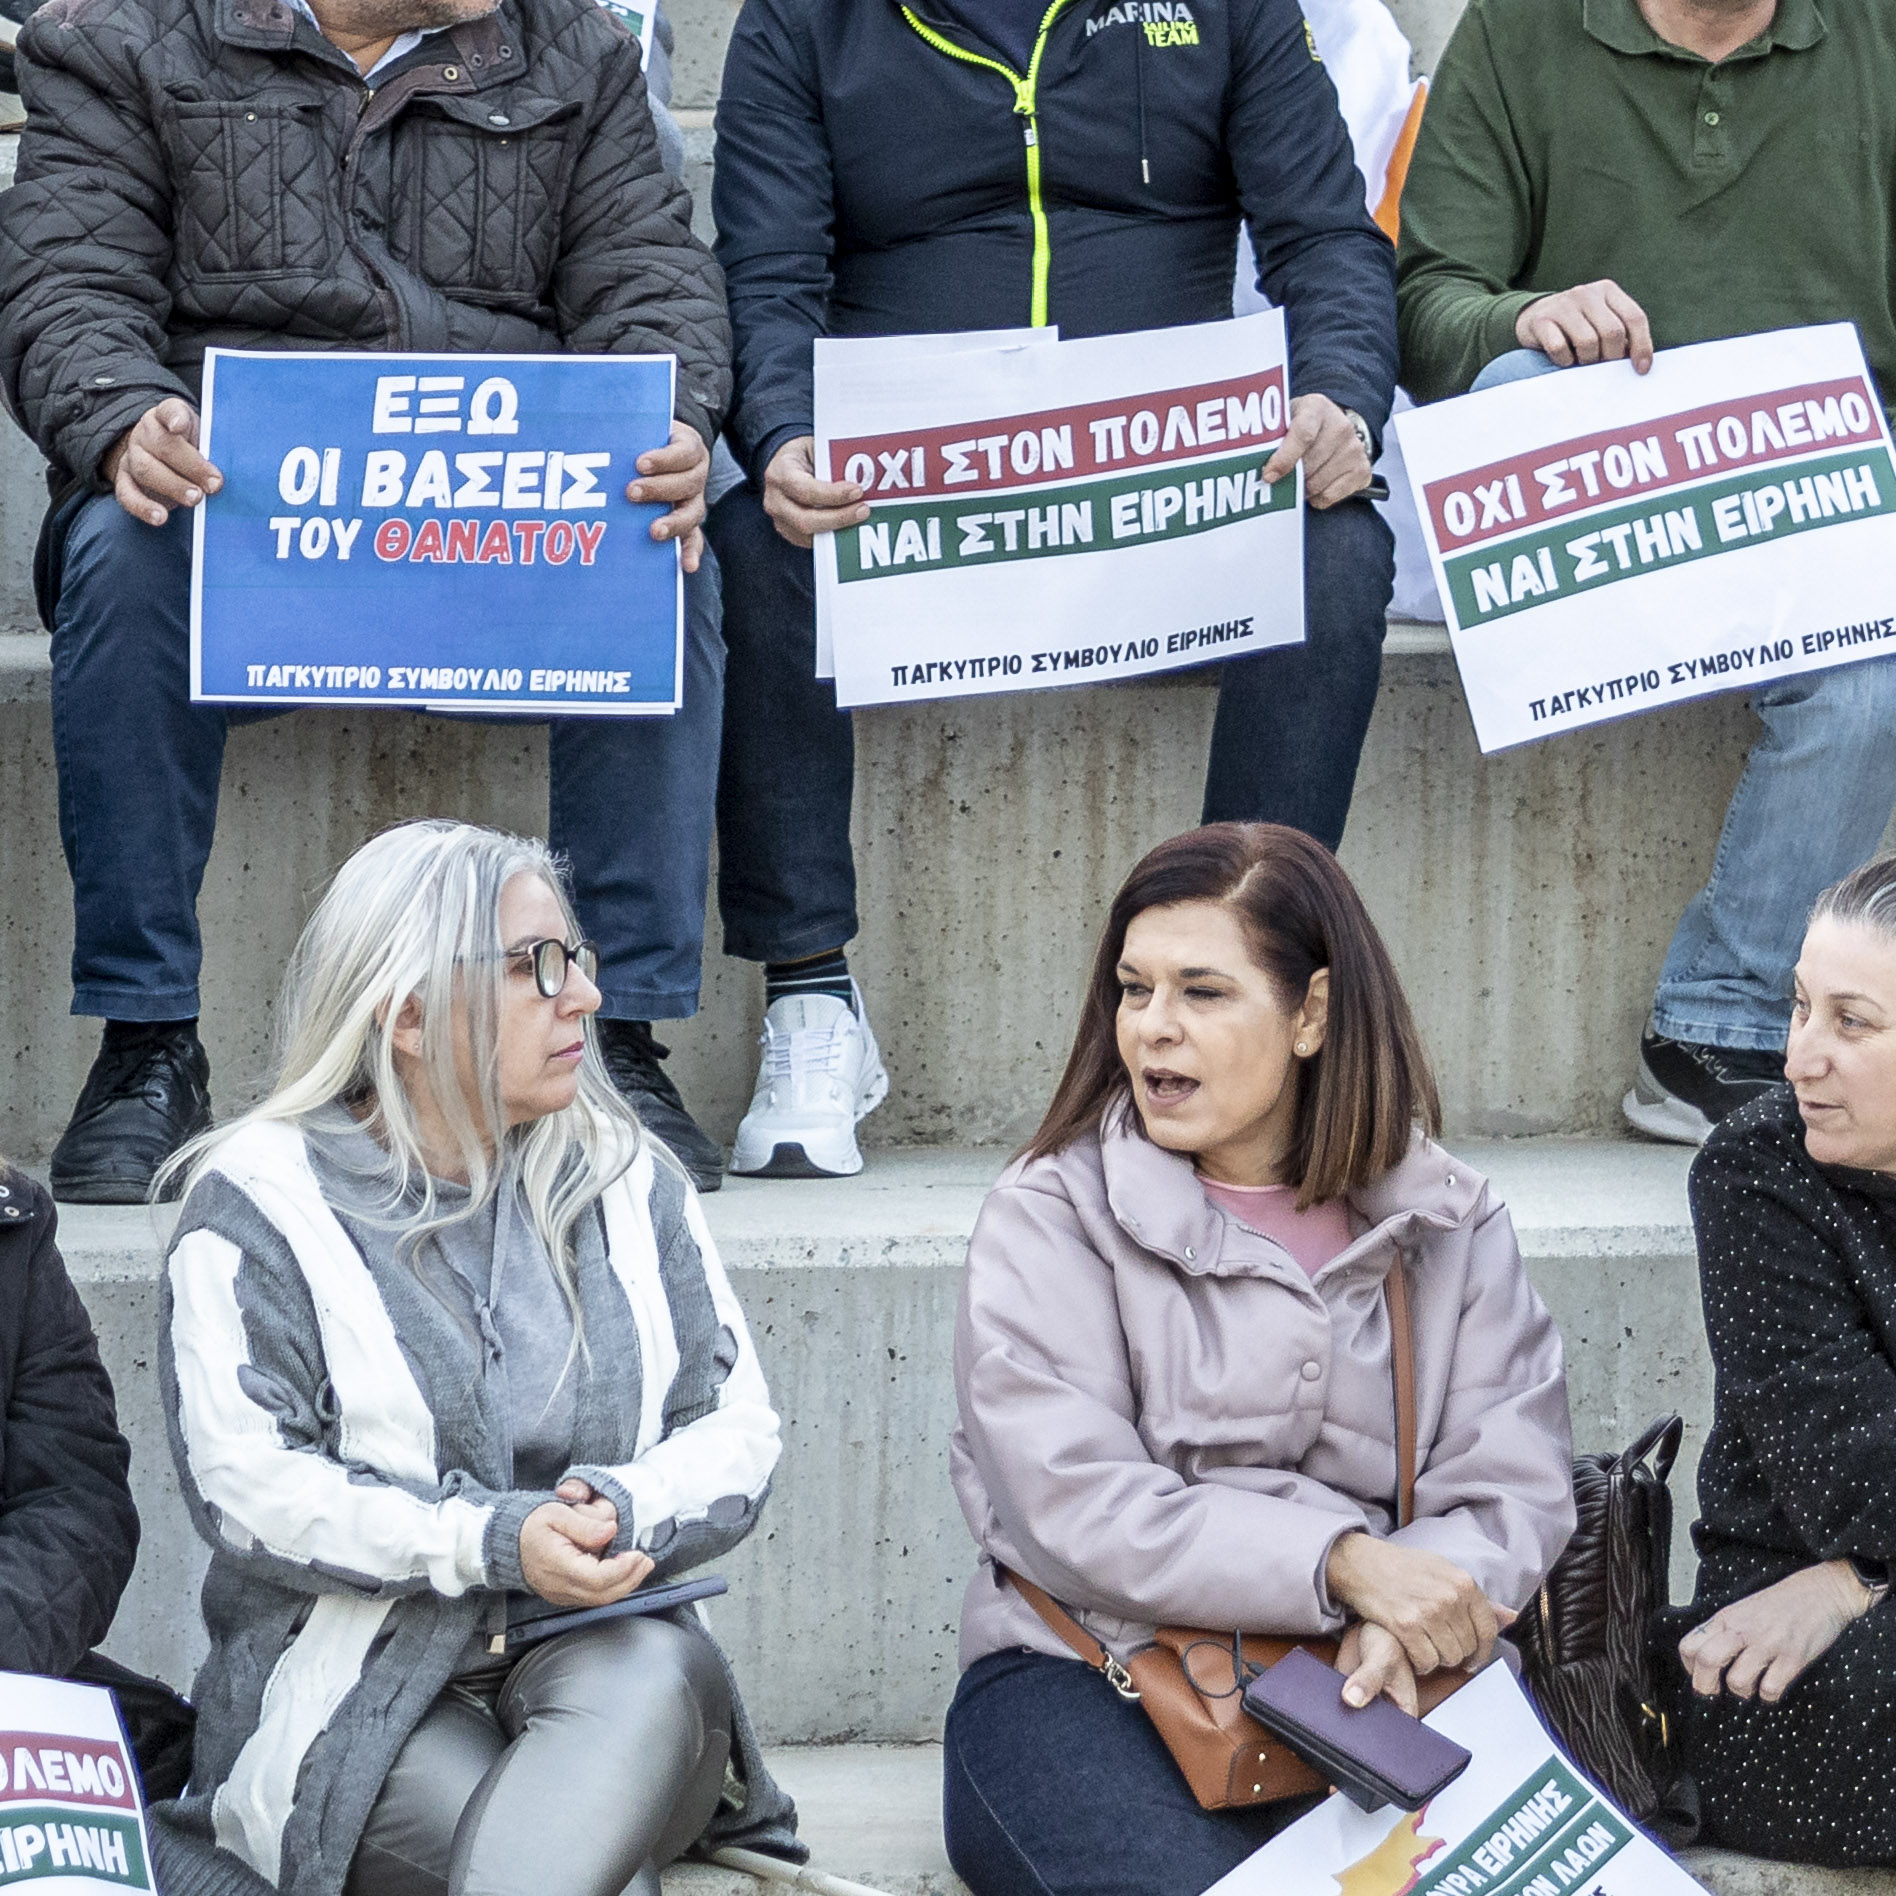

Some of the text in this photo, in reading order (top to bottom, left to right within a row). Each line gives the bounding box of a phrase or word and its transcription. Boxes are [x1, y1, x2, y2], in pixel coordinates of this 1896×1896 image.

[1086, 2, 1194, 37] MARINA
[1147, 30, 1200, 47] TEAM
[373, 376, 519, 436] ΕΞΩ
[844, 385, 1283, 493] ΟΧΙ ΣΤΟΝ ΠΟΛΕΜΟ
[278, 446, 611, 510] ΟΙ ΒΑΣΕΙΣ
[1443, 390, 1872, 538] ΟΧΙ ΣΤΟΝ ΠΟΛΕΜΟ
[269, 516, 608, 566] ΤΟΥ ΘΑΝΑΤΟΥ
[859, 466, 1273, 571] ΝΑΙ ΣΤΗΝ ΕΙΡΗΝΗ
[1470, 464, 1882, 615] ΝΑΙ ΣΤΗΝ ΕΙΡΗΝΗ
[247, 664, 632, 693] ΠΑΓΚΥΠΡΙΟ ΣΥΜΒΟΥΛΙΟ ΕΙΡΗΝΗΣ
[891, 616, 1255, 687] ΠΑΓΚΥΠΡΙΟ ΣΥΜΒΟΥΛΙΟ ΕΙΡΗΝΗΣ
[1529, 617, 1896, 722] ΠΑΓΚΥΠΡΙΟ ΣΥΜΒΟΥΛΙΟ ΕΙΡΗΝΗΣ
[1471, 1777, 1574, 1876] ΕΙΡΗΝΗΣ
[1549, 1820, 1617, 1887] ΛΑΩΝ
